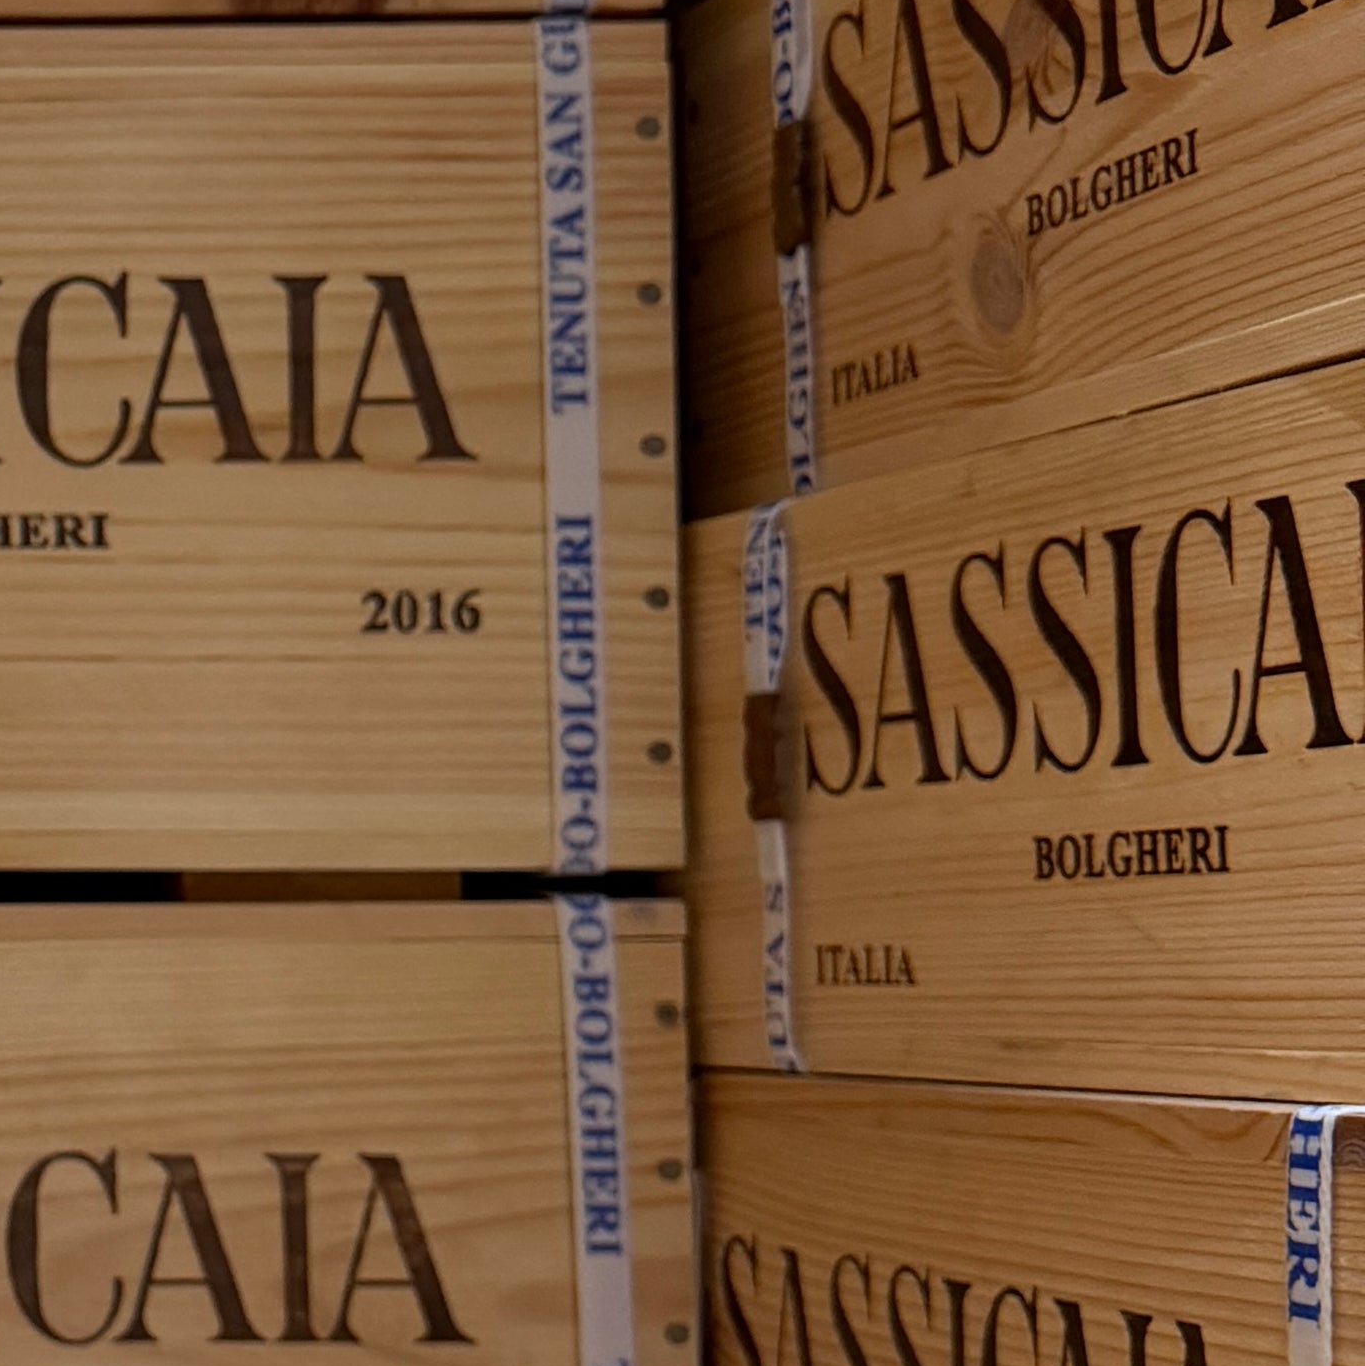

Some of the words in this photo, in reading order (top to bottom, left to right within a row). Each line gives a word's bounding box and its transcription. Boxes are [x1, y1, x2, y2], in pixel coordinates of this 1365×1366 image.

[544, 92, 585, 192] SAN
[1026, 128, 1199, 236] BOLGHERI
[547, 205, 589, 414] TENUTA
[830, 342, 919, 406] ITALIA
[361, 588, 482, 634] 2016
[1034, 825, 1229, 881] BOLGHERI
[815, 944, 915, 986] ITALIA
